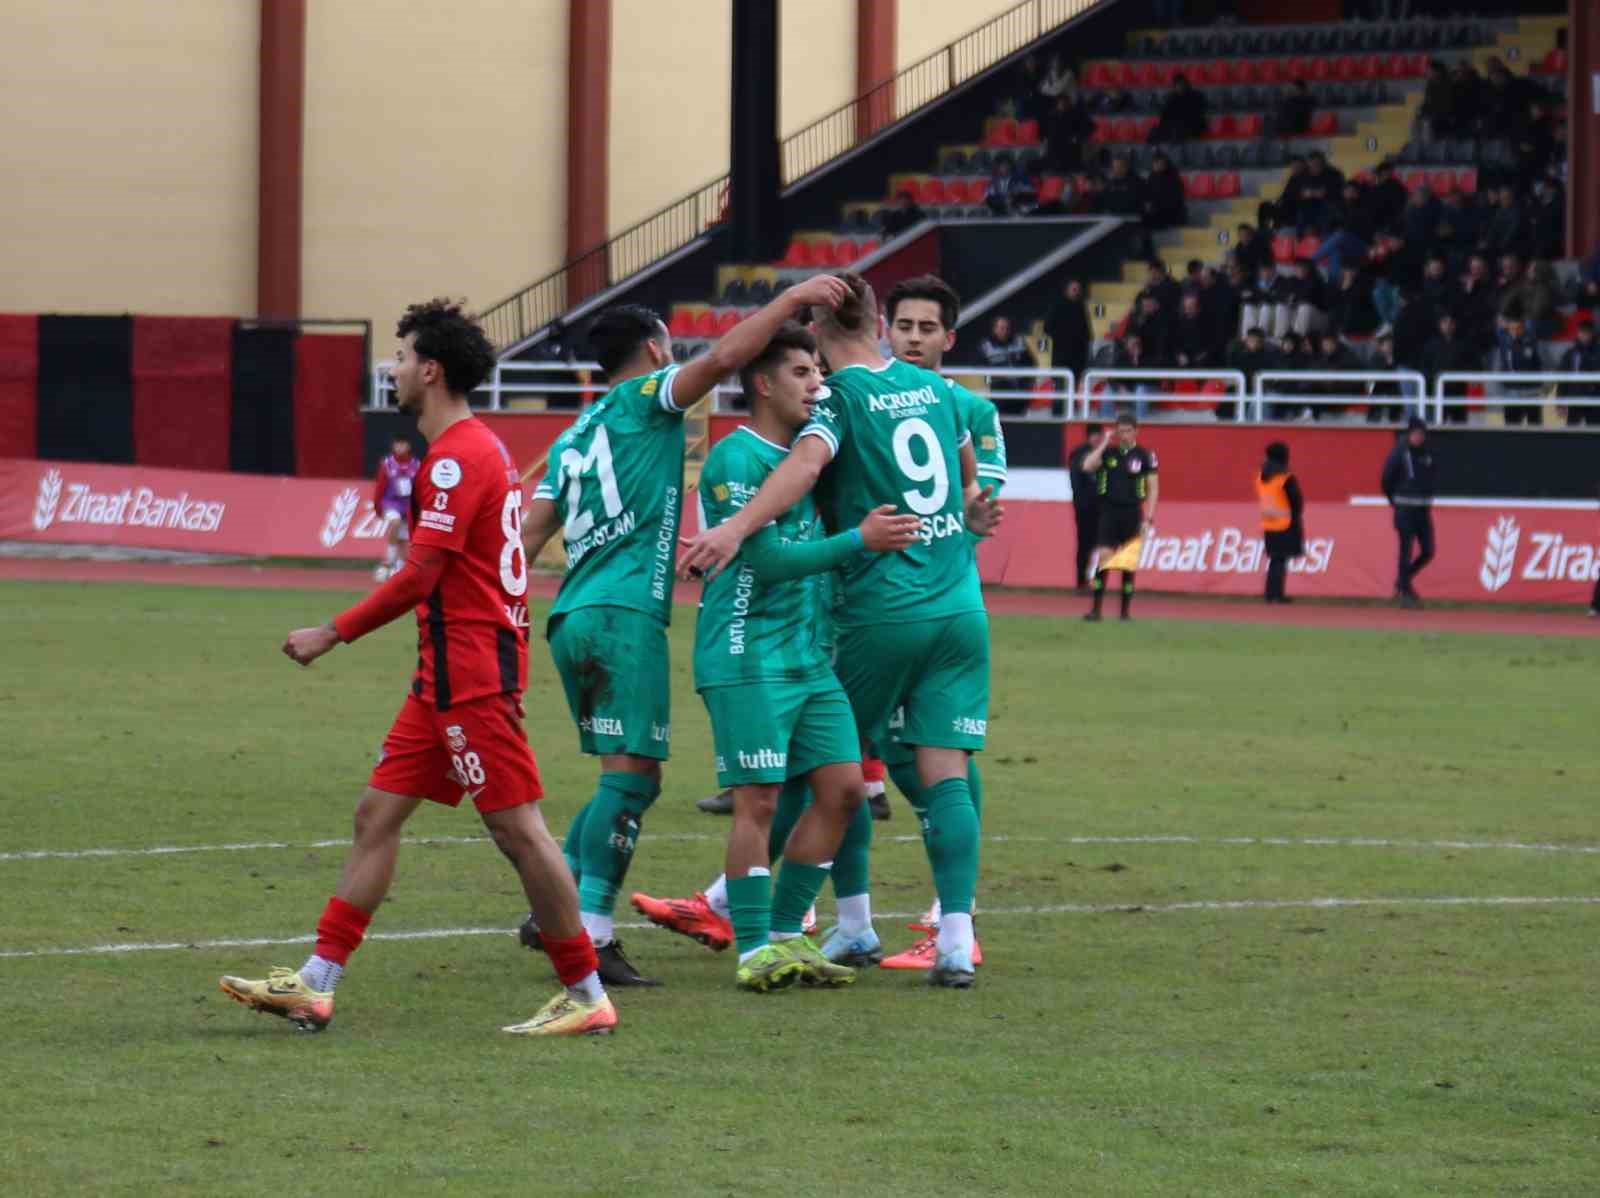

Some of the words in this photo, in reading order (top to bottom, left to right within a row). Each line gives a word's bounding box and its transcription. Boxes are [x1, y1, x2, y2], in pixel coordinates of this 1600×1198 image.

[868, 385, 940, 411] ACROPOL
[559, 423, 624, 543] 21
[892, 417, 949, 515] 9
[60, 484, 131, 525] Ziraat
[127, 487, 226, 532] Bankası
[655, 486, 678, 561] LOGISTICS
[1136, 525, 1213, 572] iraat
[1214, 526, 1335, 574] Banası
[652, 562, 667, 601] BATU
[729, 619, 745, 655] BATU
